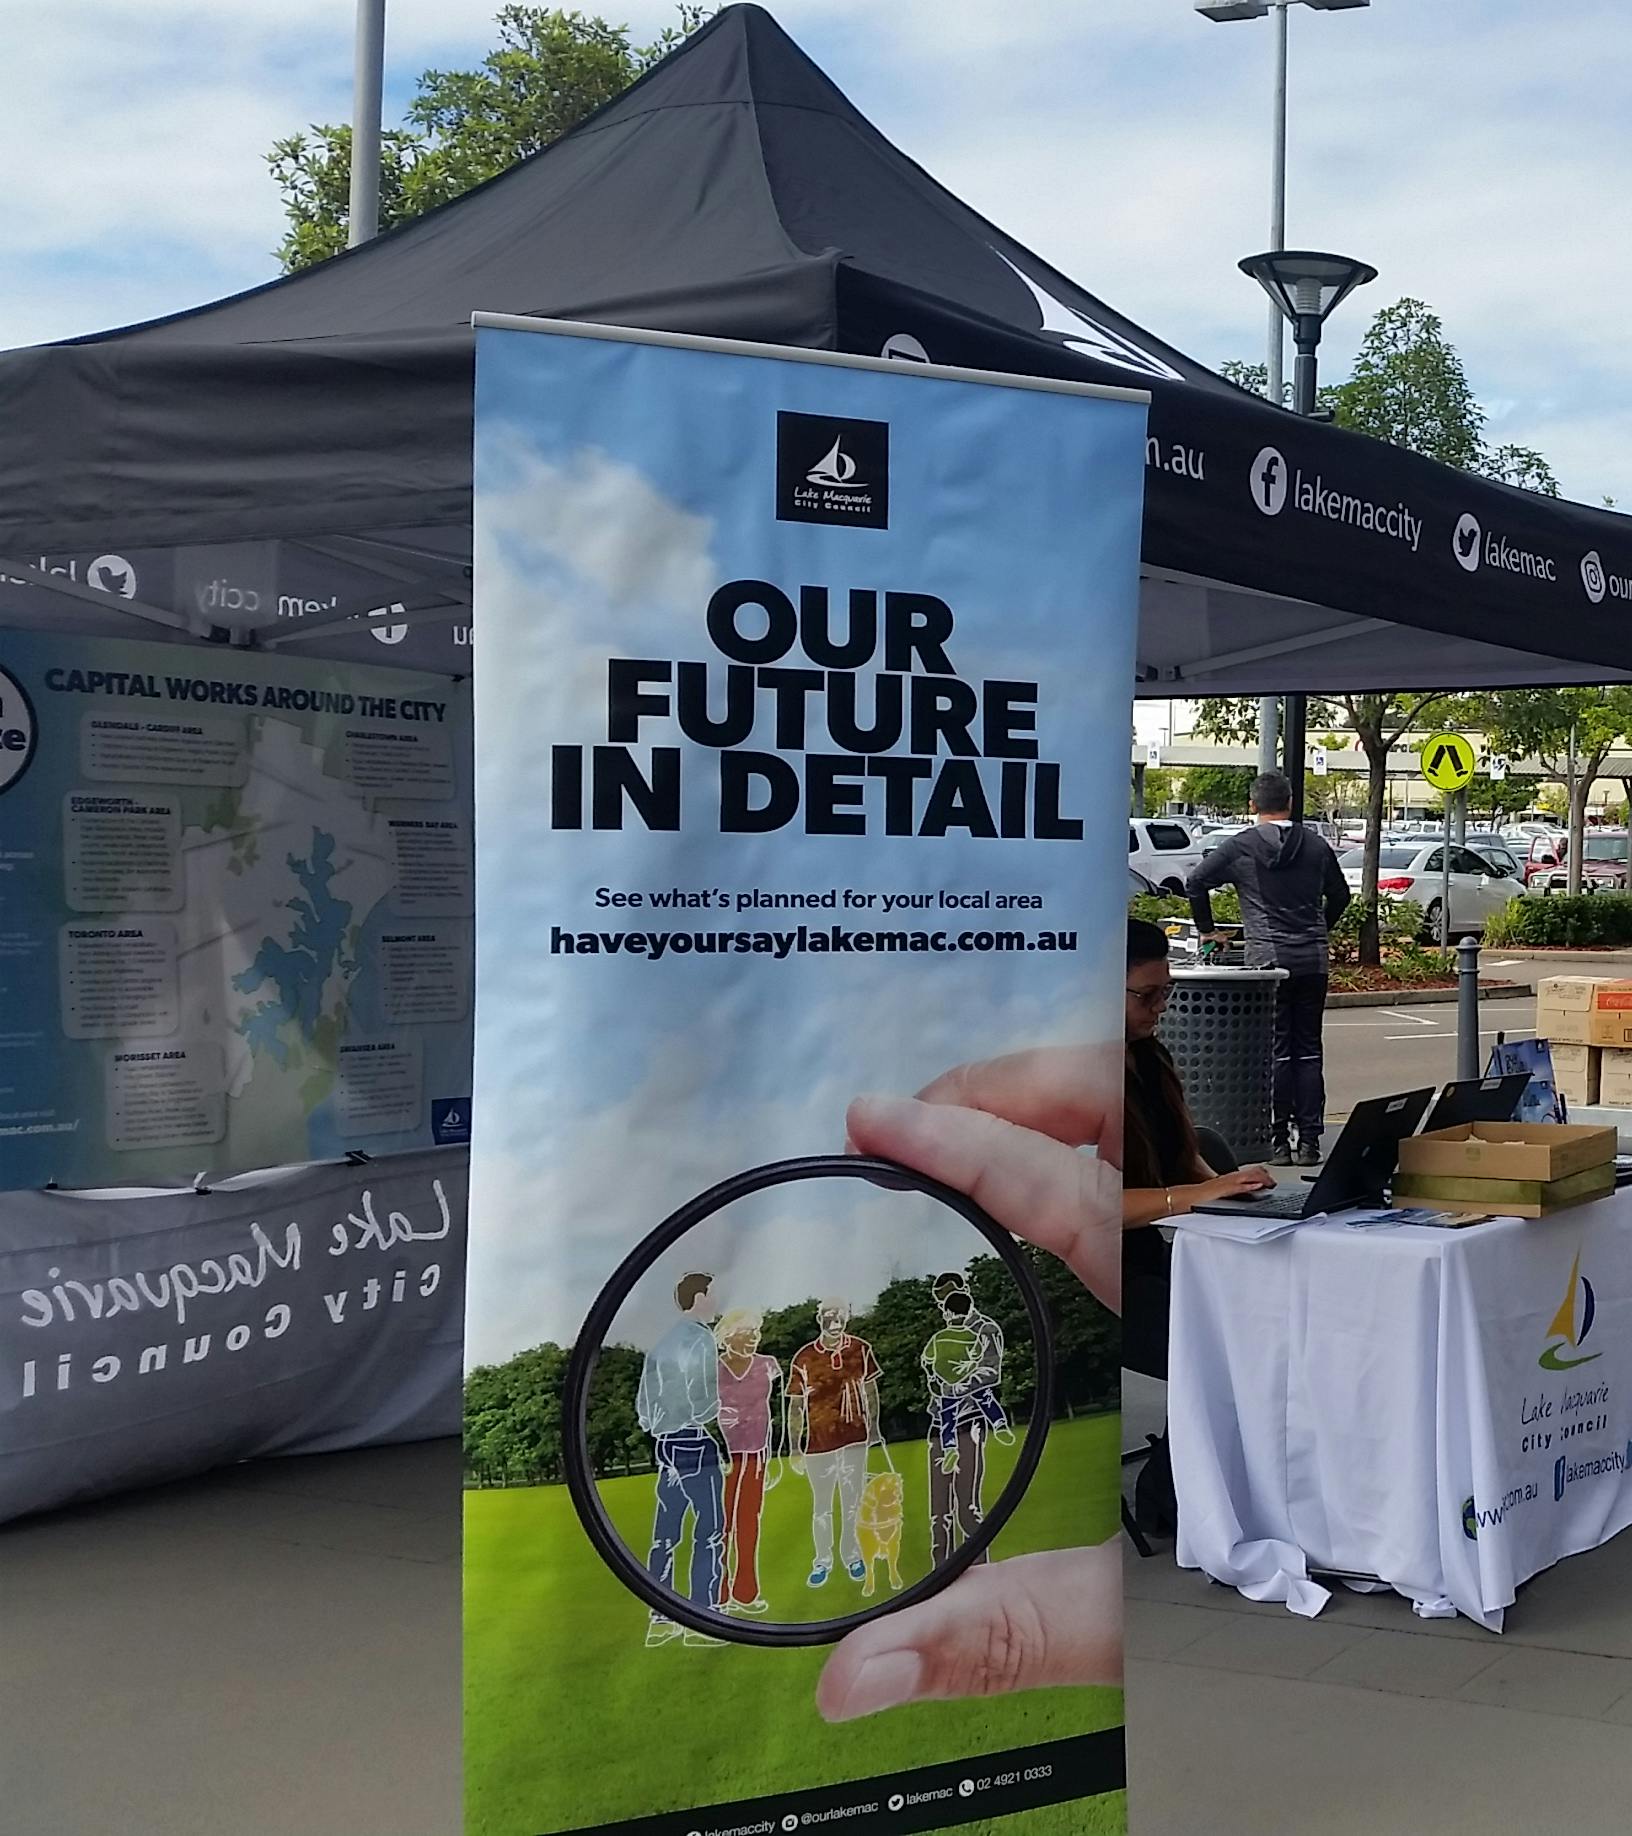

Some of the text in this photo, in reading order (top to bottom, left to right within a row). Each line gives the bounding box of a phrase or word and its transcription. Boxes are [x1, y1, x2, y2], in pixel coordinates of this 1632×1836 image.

[794, 486, 872, 505] Lake Macquarie
[794, 499, 871, 513] City Council
[1294, 469, 1422, 551] lakemaccity
[1484, 531, 1556, 583] lakemac
[706, 579, 956, 676] OUR
[44, 668, 446, 723] CAPITAL WORKS AROUND THE CITY
[608, 658, 1039, 760] FUTURE
[182, 726, 203, 735] AREA
[551, 745, 680, 832] IN
[720, 750, 1084, 841] DETAIL
[149, 806, 171, 815] AREA
[594, 887, 1043, 915] See what's planned for your local area
[68, 929, 144, 938] TORONTO AREA
[550, 926, 1078, 960] haveyoursaylakemac.com.au
[115, 1051, 186, 1062] MORISSET AREA
[1521, 1393, 1552, 1425] Lake
[1521, 1433, 1552, 1453] City
[801, 1800, 879, 1826] @ourlakemac
[906, 1786, 953, 1806] lakemac
[976, 1776, 992, 1792] 02
[993, 1770, 1022, 1789] 4921
[1024, 1763, 1053, 1783] 0333
